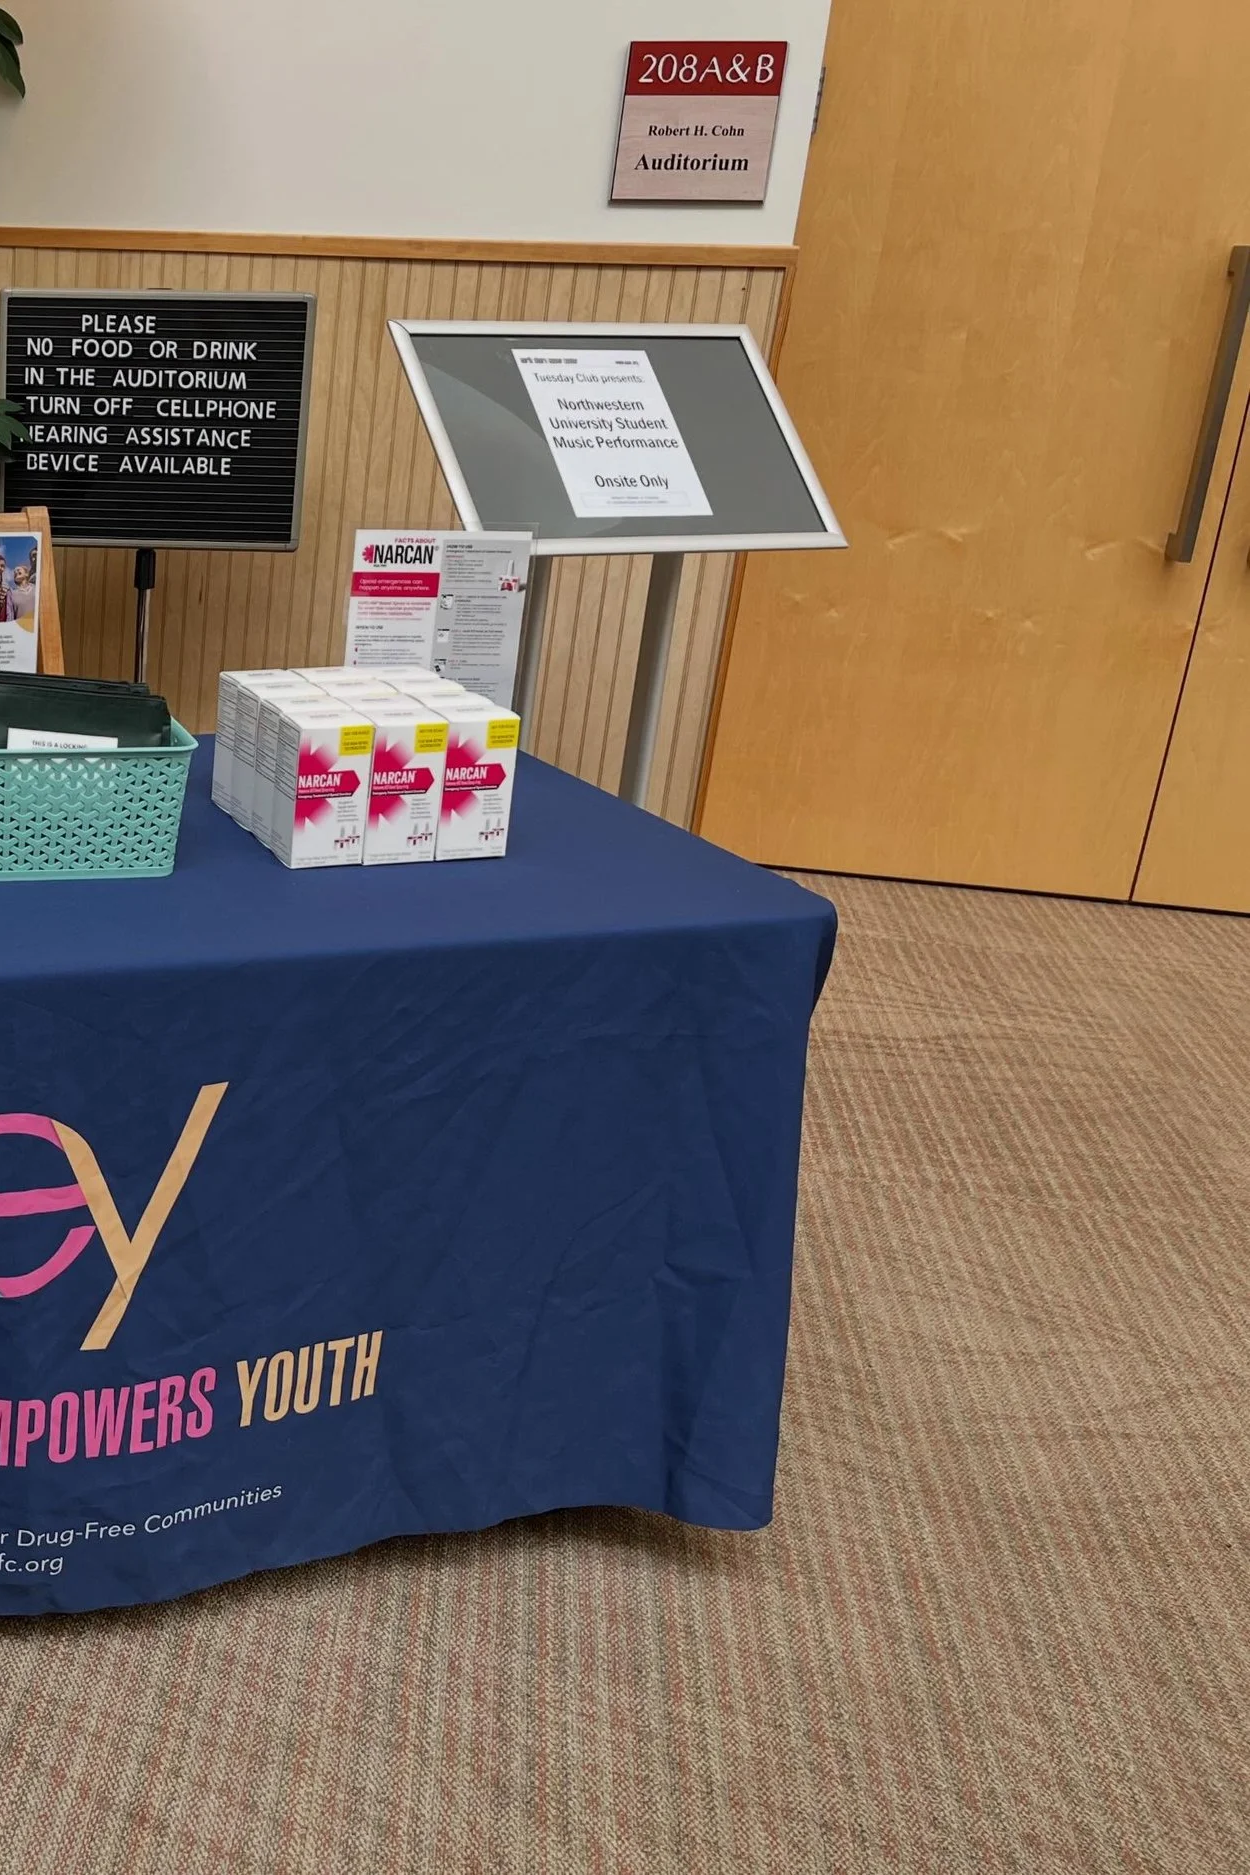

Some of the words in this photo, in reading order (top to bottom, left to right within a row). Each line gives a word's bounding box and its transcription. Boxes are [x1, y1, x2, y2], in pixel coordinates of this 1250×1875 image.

[638, 53, 775, 84] 208A&B
[648, 125, 690, 137] Robert
[693, 125, 708, 137] H.
[711, 125, 745, 137] Cohn
[634, 153, 749, 171] Auditorium
[81, 314, 156, 334] PLEASE
[71, 338, 133, 358] FOOD
[149, 340, 178, 359] OR
[192, 341, 258, 361] DRINK
[24, 367, 44, 385] IN
[56, 367, 95, 387] THE
[112, 369, 247, 390] AUDITORIUM
[534, 372, 574, 384] Tuesday
[576, 372, 599, 383] Club
[26, 396, 81, 415] TURN
[93, 397, 134, 416] OFF
[156, 399, 277, 420] CELLPHONE
[557, 398, 645, 411] Northwestern
[549, 417, 614, 431] University
[615, 416, 668, 430] Student
[125, 427, 252, 449] ASSISTANCE
[553, 436, 595, 449] Music
[596, 436, 680, 449] Performance
[119, 456, 232, 476] AVAILABLE
[594, 475, 638, 488] Onsite
[639, 475, 670, 489] Only
[374, 544, 434, 564] NARCAN
[32, 739, 46, 747] THIS
[298, 773, 341, 788] NARCAN
[373, 771, 415, 785] NARCAN
[446, 766, 487, 780] NARCAN
[236, 1330, 384, 1427] YOUTH
[17, 1520, 136, 1551] Drug-Free
[144, 1484, 283, 1535] Communities
